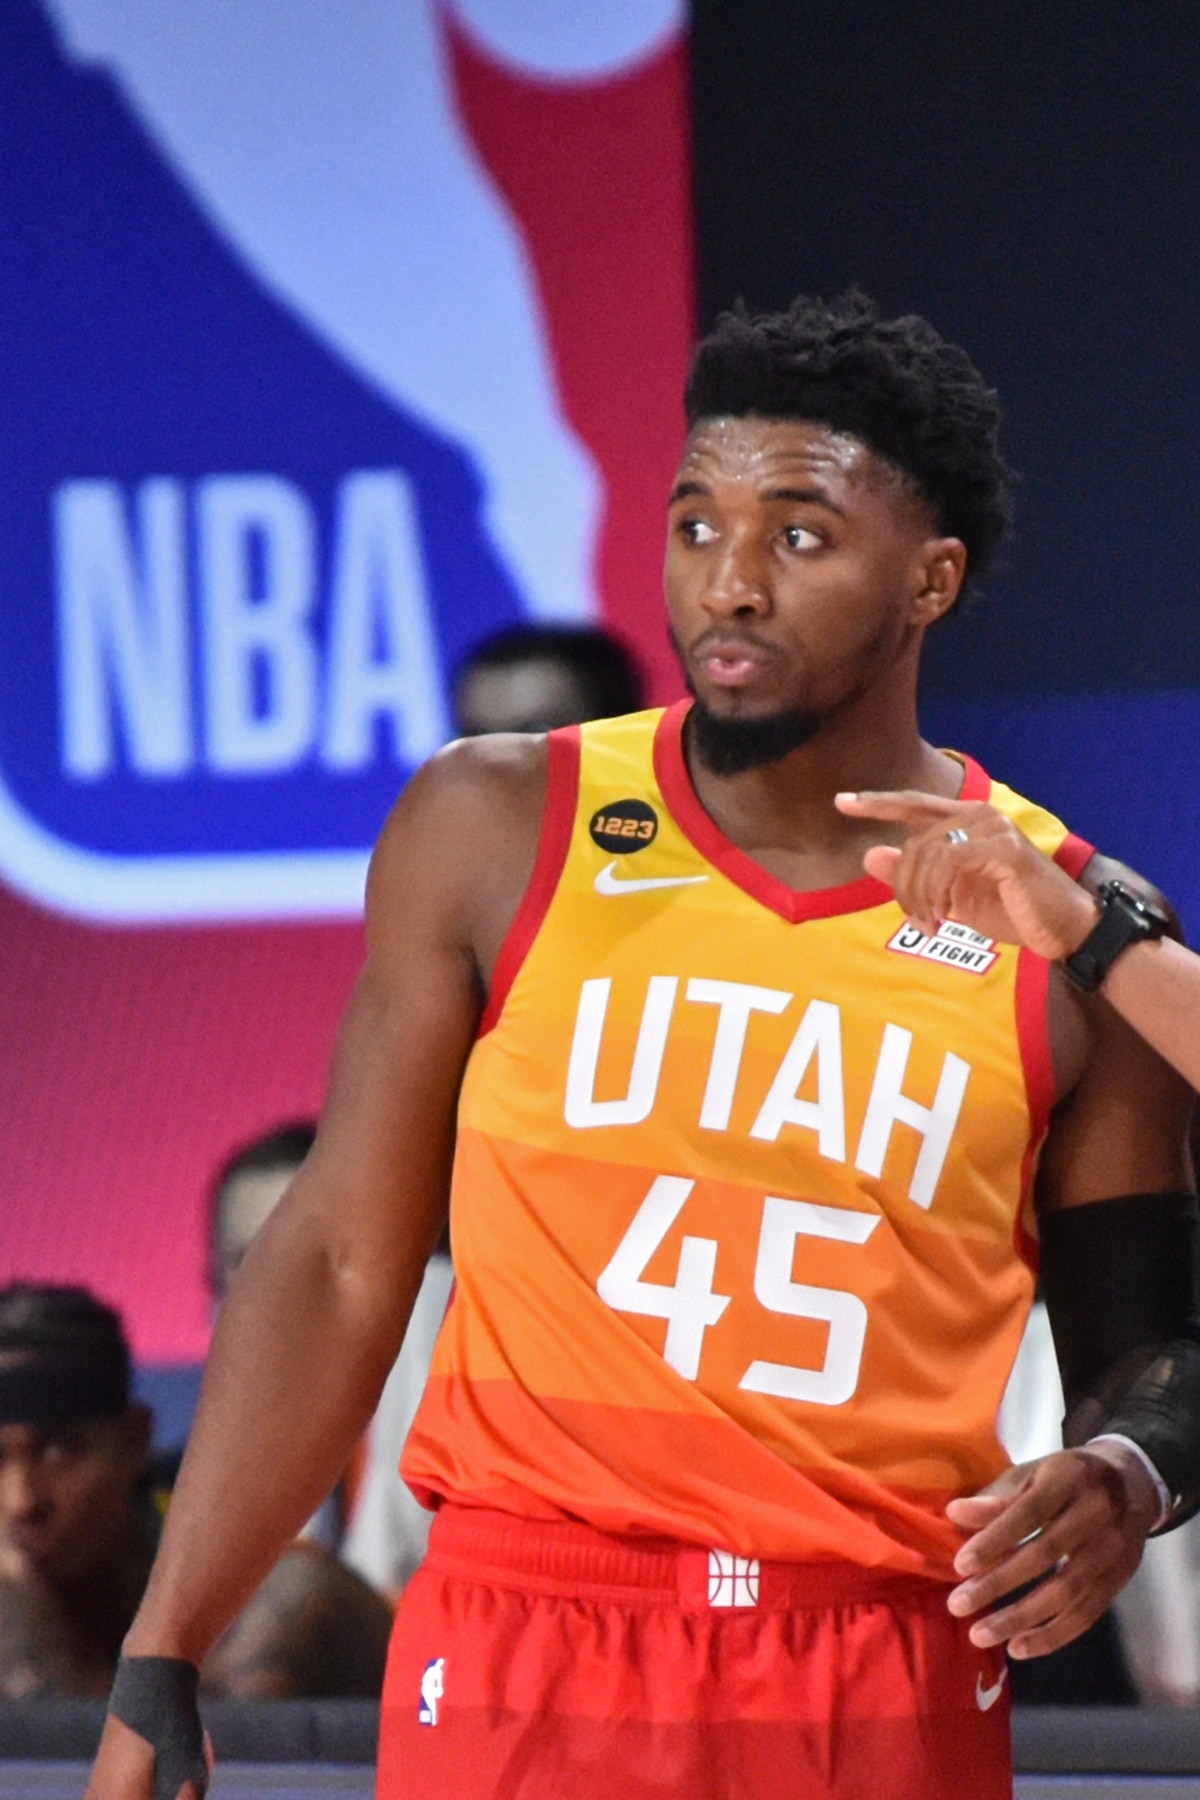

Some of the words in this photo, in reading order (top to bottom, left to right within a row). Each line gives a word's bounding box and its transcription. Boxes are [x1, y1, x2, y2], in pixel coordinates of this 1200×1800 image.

[54, 468, 448, 778] NBA
[594, 815, 655, 840] 1223
[928, 941, 987, 967] FIGHT
[945, 925, 966, 938] FOR
[564, 975, 971, 1210] UTAH
[596, 1174, 881, 1406] 45
